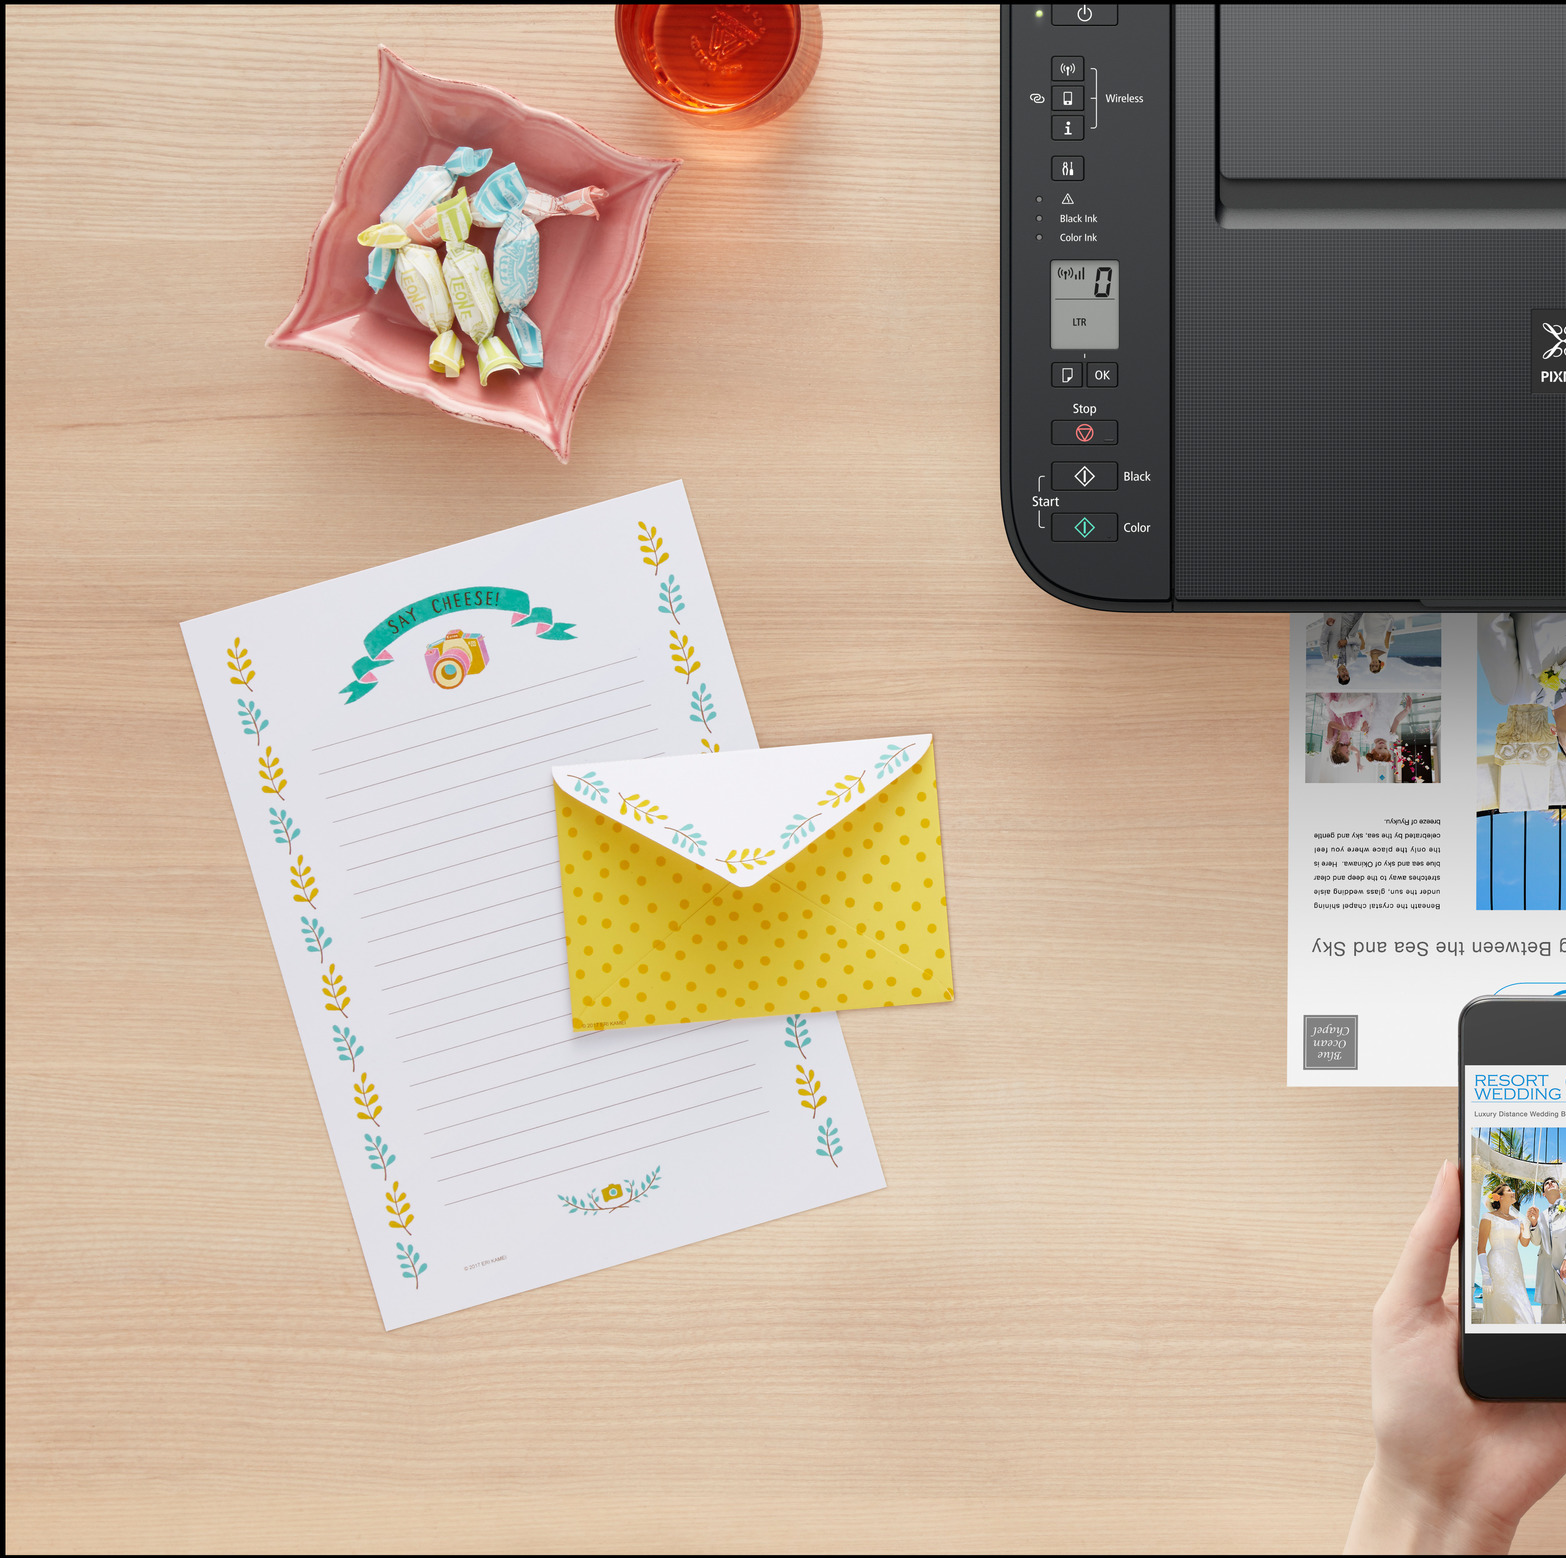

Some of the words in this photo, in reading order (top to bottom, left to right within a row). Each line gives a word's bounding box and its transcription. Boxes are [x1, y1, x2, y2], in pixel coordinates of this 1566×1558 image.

[1105, 93, 1144, 104] Wireless
[1059, 213, 1083, 223] Black
[1084, 213, 1098, 223] Ink
[1059, 232, 1083, 242] Color
[1084, 232, 1098, 242] Ink
[401, 268, 426, 314] LEONE
[450, 276, 474, 320] LEONE
[1072, 317, 1087, 327] LTR
[1094, 369, 1111, 381] OK
[1072, 403, 1097, 417] Stop
[1123, 470, 1152, 482] Black
[1032, 495, 1060, 507] Start
[1123, 521, 1151, 533] Color
[387, 607, 417, 635] SAY
[431, 591, 500, 613] CHEESE!
[1384, 817, 1410, 826] Ryukyu.
[1410, 818, 1418, 826] of
[1418, 818, 1441, 826] breeze
[1313, 831, 1336, 840] gentle
[1336, 832, 1350, 840] and
[1351, 831, 1364, 840] sky
[1381, 832, 1393, 840] the
[1394, 831, 1403, 840] by
[1404, 832, 1441, 840] celebrated
[1314, 846, 1329, 854] feel
[1330, 845, 1345, 853] you
[1346, 846, 1370, 854] where
[1372, 846, 1393, 854] place
[1395, 846, 1408, 854] the
[1410, 845, 1427, 854] only
[1428, 846, 1441, 854] the
[1313, 860, 1320, 868] is
[1321, 860, 1338, 868] Here
[1341, 860, 1374, 868] Okinawa.
[1374, 860, 1383, 868] of
[1383, 859, 1396, 868] sky
[1397, 860, 1411, 868] and
[1425, 860, 1441, 868] blue
[1313, 874, 1331, 882] clear
[1347, 874, 1366, 882] deep
[1388, 873, 1407, 881] away
[1408, 874, 1441, 882] stretches
[1332, 887, 1364, 896] wedding
[1366, 887, 1386, 896] glass
[1313, 901, 1341, 910] shining
[1342, 902, 1367, 910] chapel
[1369, 901, 1394, 910] crystal
[1311, 937, 1346, 957] Sky
[1353, 941, 1387, 957] and
[1393, 941, 1429, 957] Sea
[1435, 941, 1465, 957] the
[1472, 941, 1551, 957] Between
[1310, 1024, 1350, 1037] Chapel
[1313, 1040, 1346, 1049] Ocean
[1317, 1051, 1342, 1061] Blue
[1475, 1074, 1550, 1087] RESORT
[1473, 1087, 1562, 1101] WEDDING
[1474, 1110, 1497, 1119] Luxury
[1498, 1110, 1528, 1118] Distance
[1529, 1110, 1559, 1119] Wedding
